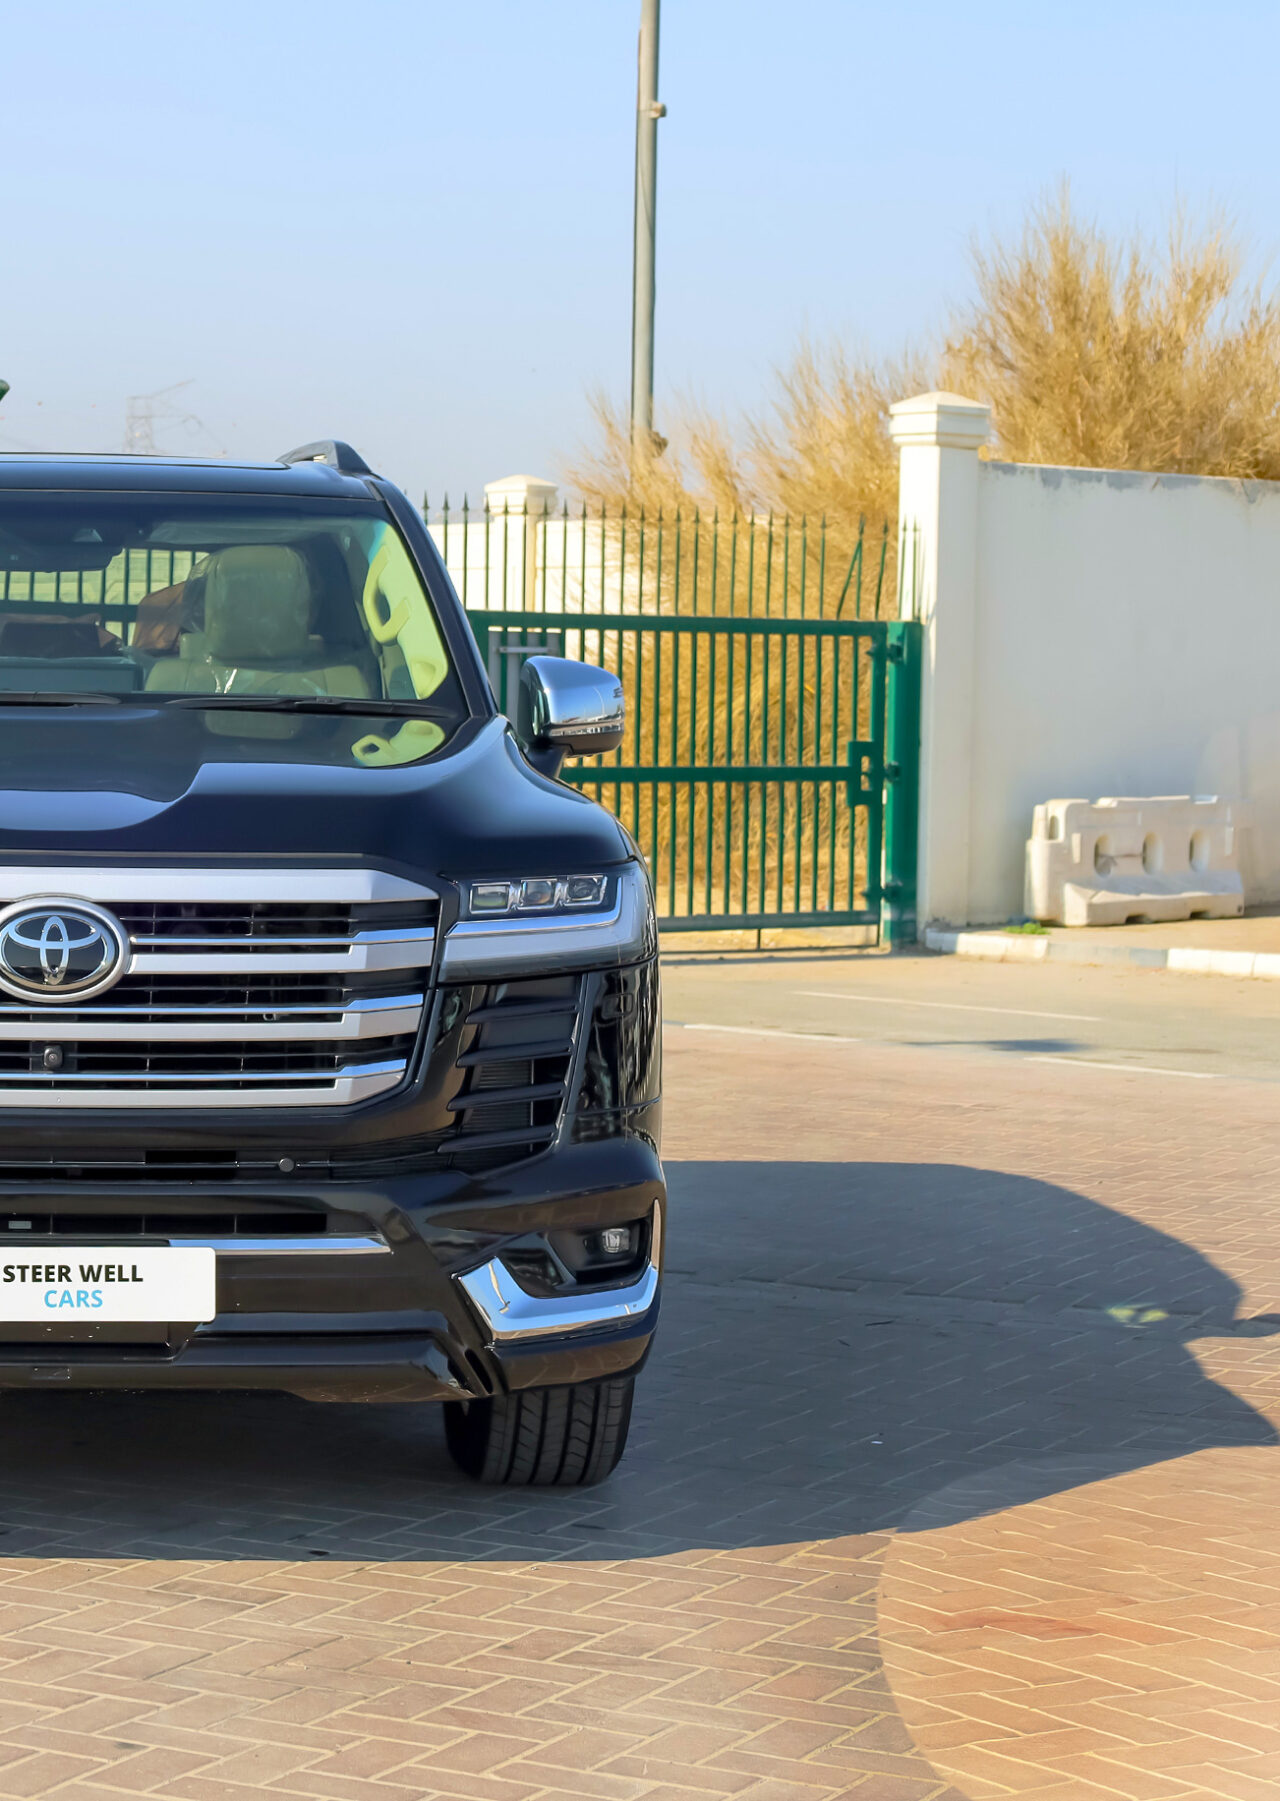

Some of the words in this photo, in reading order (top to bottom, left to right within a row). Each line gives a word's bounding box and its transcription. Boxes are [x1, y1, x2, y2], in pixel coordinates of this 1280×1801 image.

[2, 1264, 72, 1283] STEER
[78, 1264, 144, 1283] WELL
[44, 1289, 104, 1309] CARS
